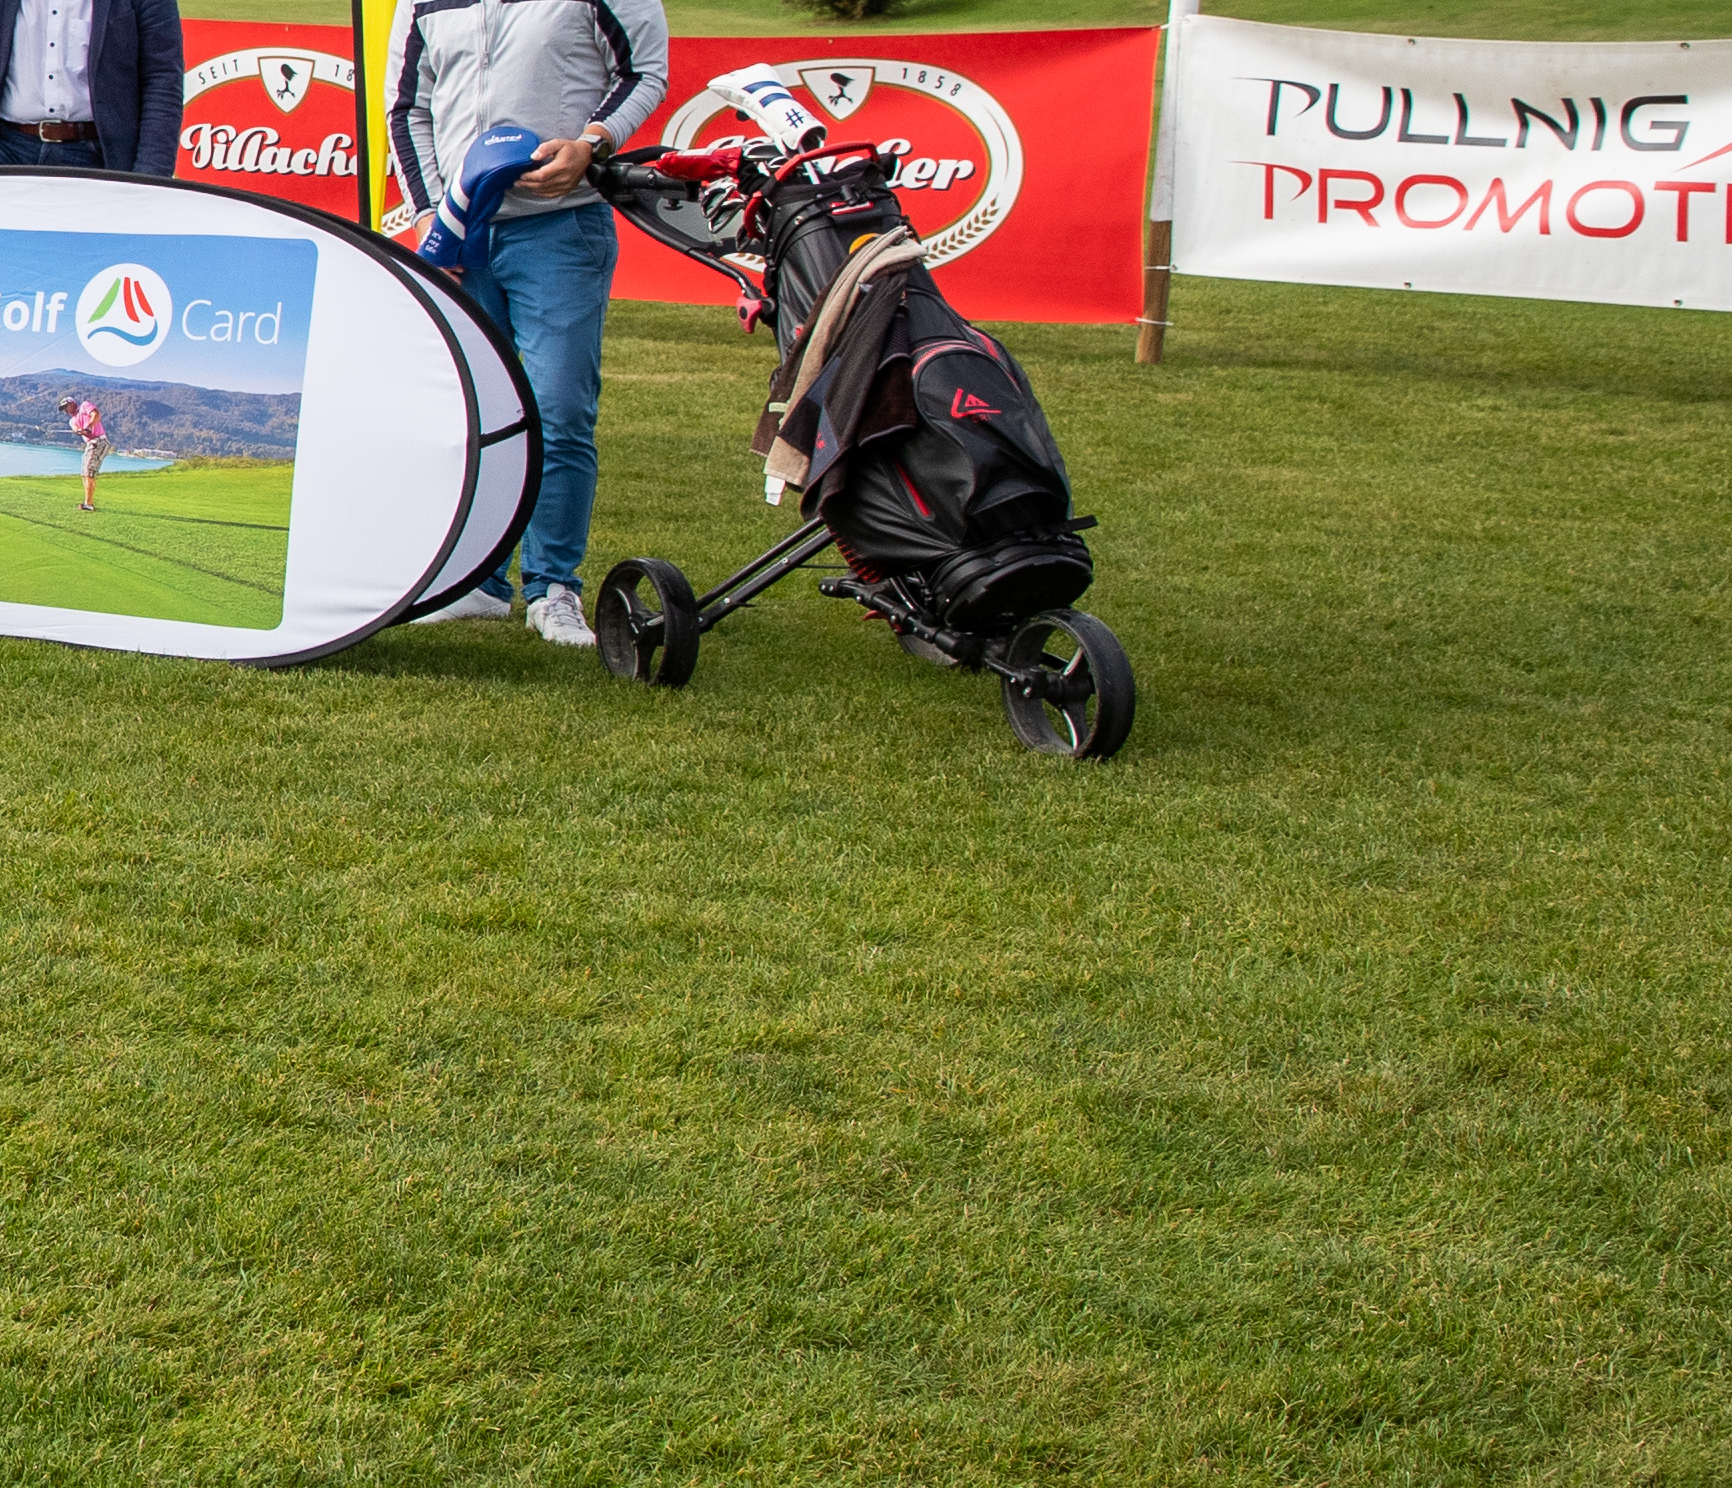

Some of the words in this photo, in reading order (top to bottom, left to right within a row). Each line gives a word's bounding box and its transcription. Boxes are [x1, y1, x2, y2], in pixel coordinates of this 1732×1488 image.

[198, 59, 240, 85] SEIT
[333, 63, 355, 82] 18
[902, 67, 962, 97] 1858
[1232, 76, 1691, 151] PULLNIG
[180, 123, 359, 178] Villach
[181, 299, 281, 347] Card
